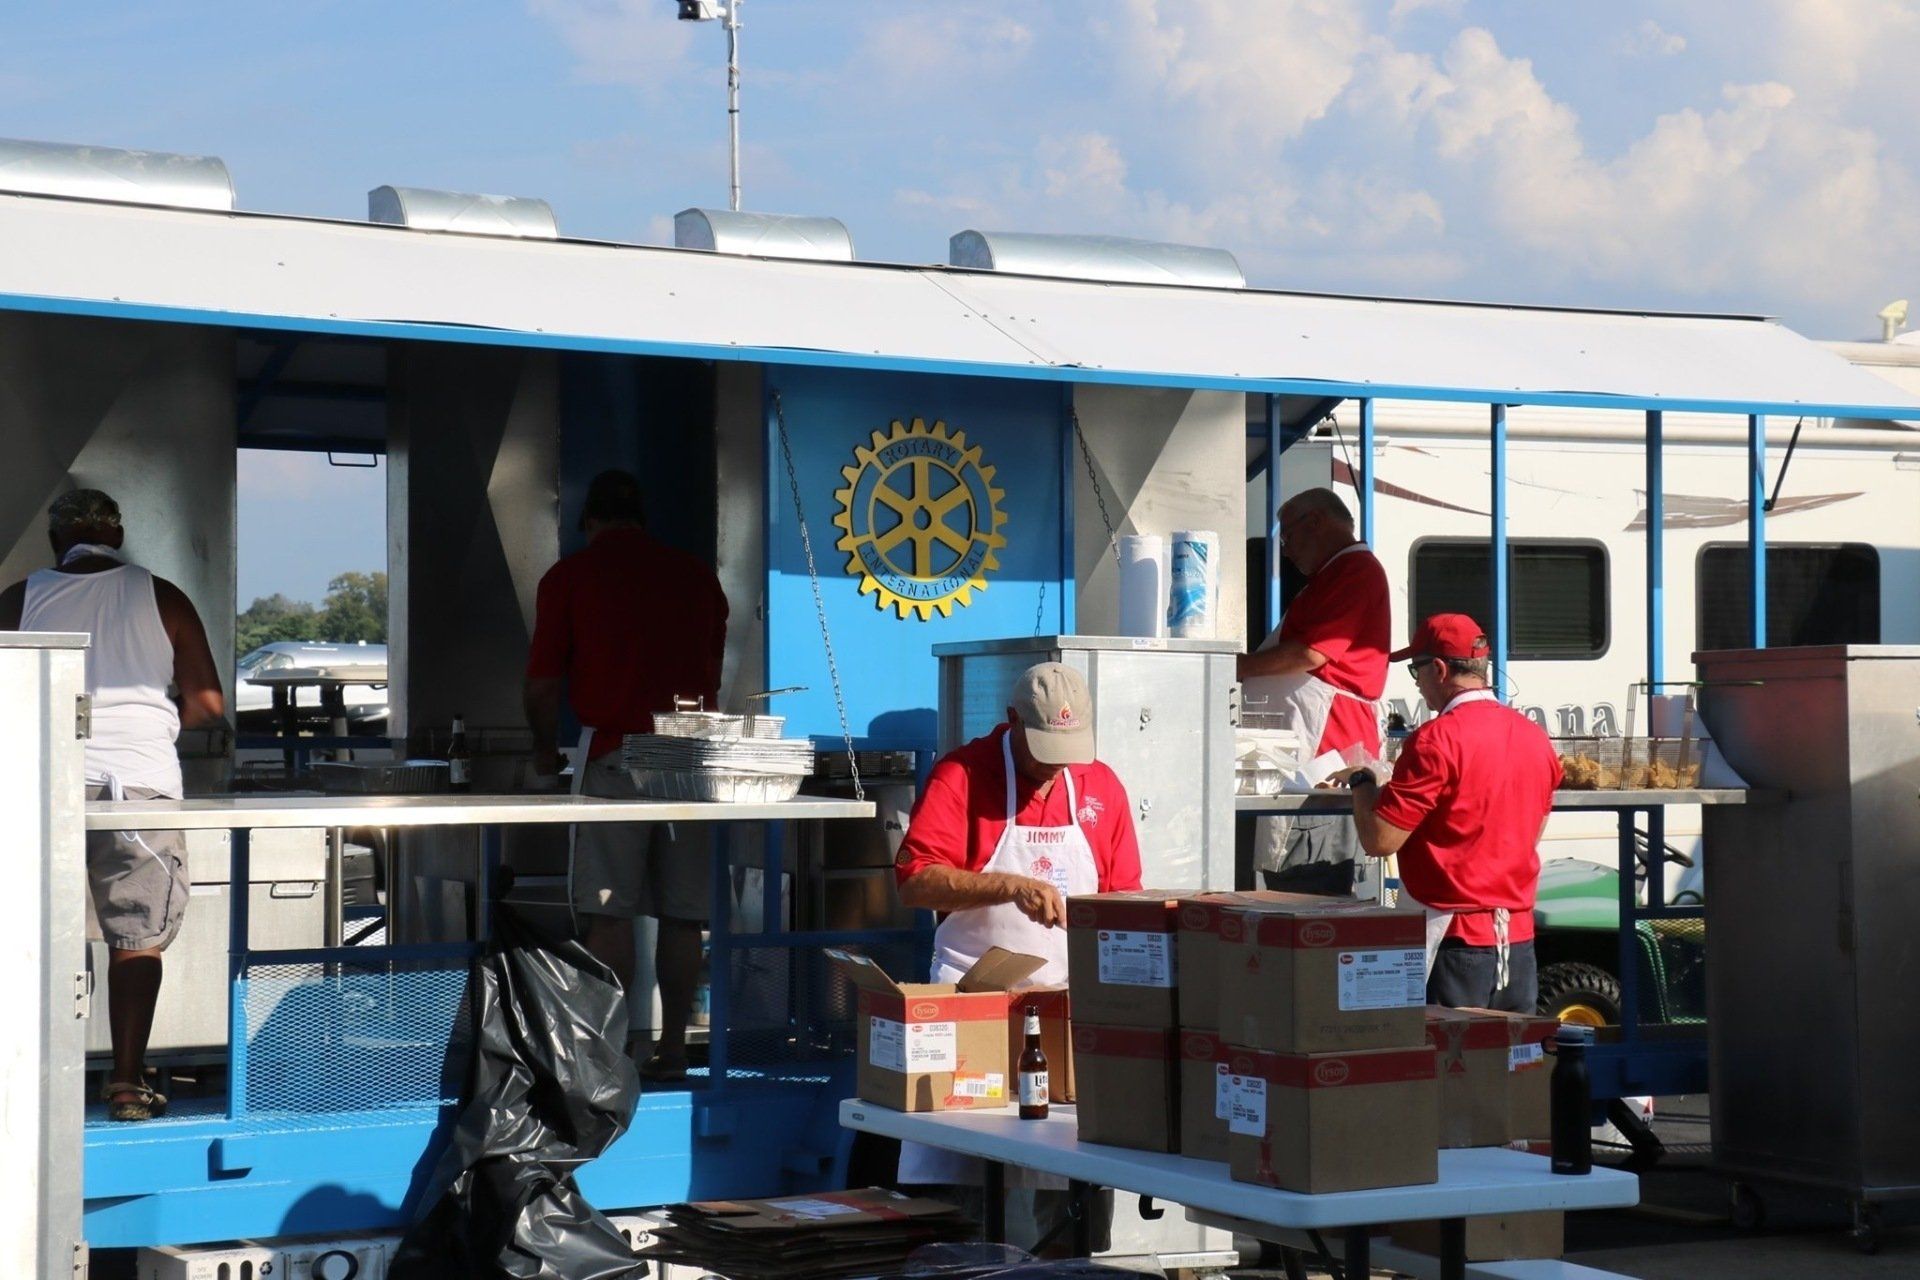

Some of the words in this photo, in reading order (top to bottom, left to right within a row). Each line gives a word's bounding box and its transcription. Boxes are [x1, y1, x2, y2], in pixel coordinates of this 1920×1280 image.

[884, 439, 956, 464] ROTARY
[863, 546, 985, 598] INTERNATIONAL
[1387, 698, 1623, 739] Mana
[1026, 830, 1066, 844] JIMMY
[1305, 926, 1333, 942] Tyson
[916, 1004, 938, 1017] Tyson
[1319, 1065, 1348, 1082] Tyson
